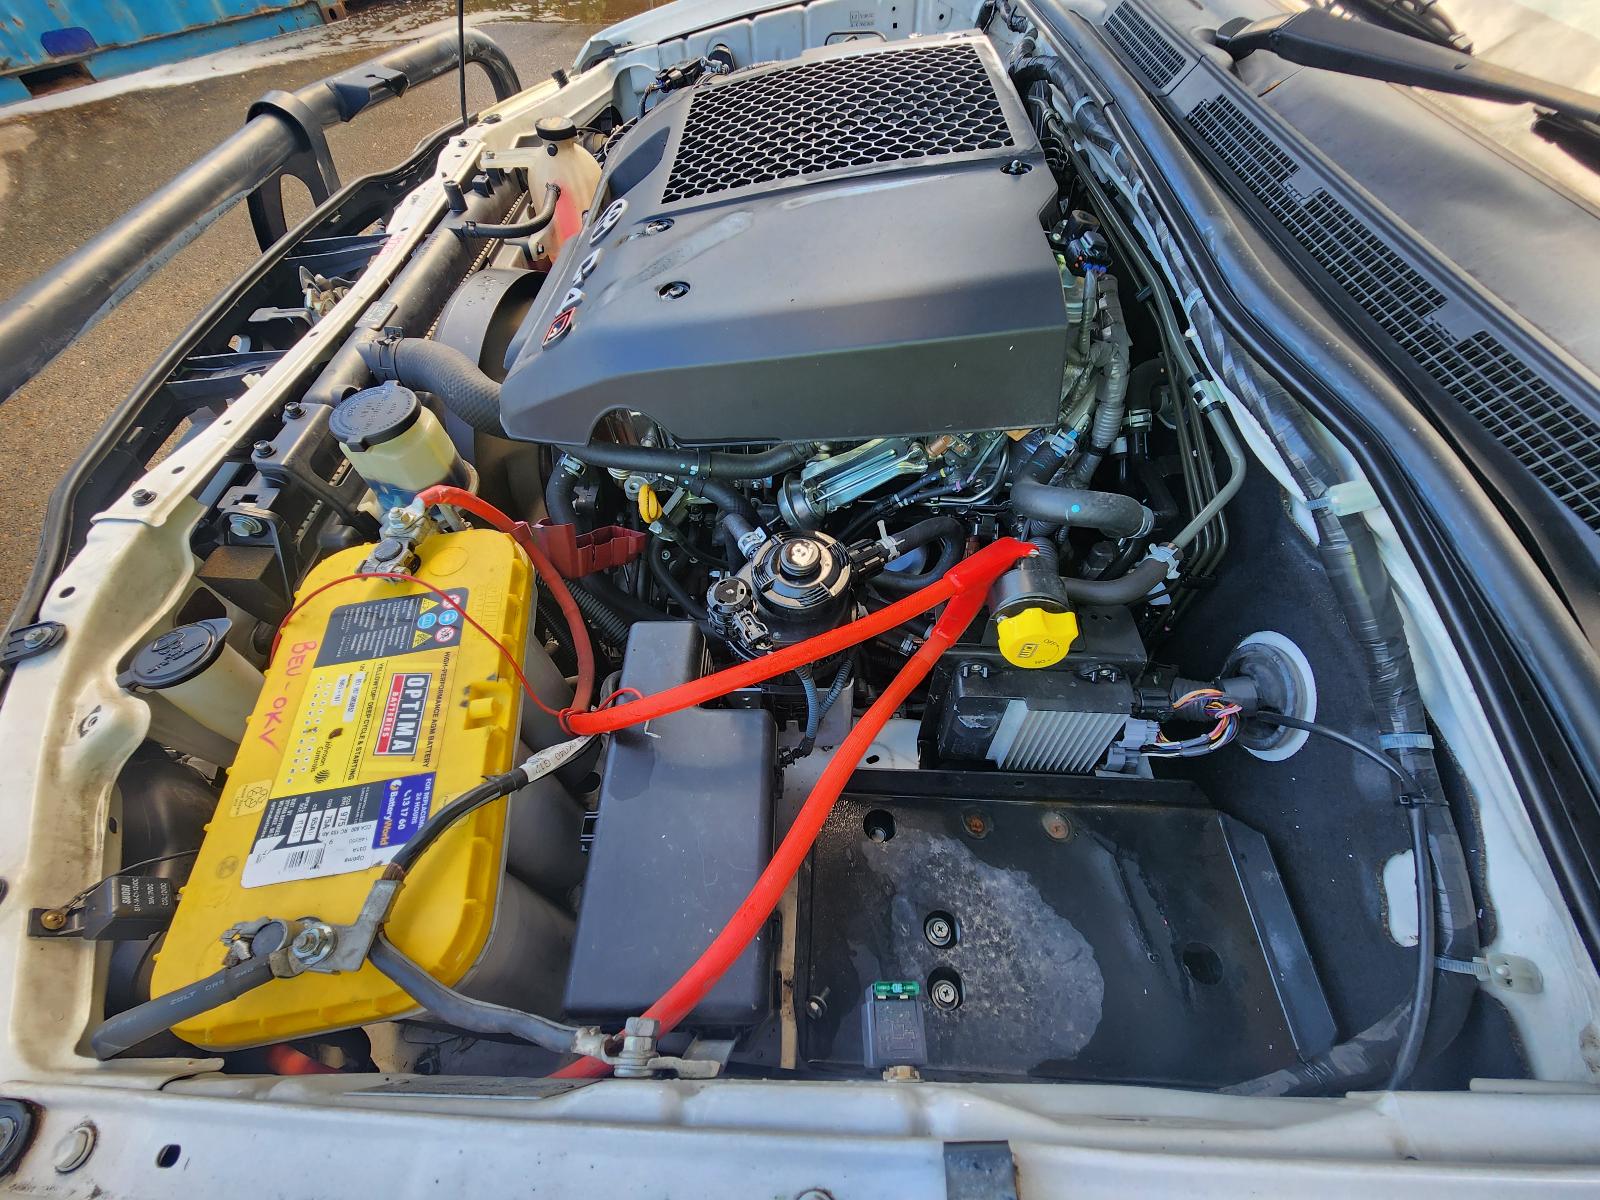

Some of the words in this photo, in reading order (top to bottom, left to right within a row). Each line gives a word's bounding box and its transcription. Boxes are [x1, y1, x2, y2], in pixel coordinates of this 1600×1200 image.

[431, 651, 450, 717] HIGH-PERFORMANCE
[363, 702, 374, 718] DEEP
[380, 691, 399, 737] BATTERIES
[390, 676, 426, 751] OPTIMA
[358, 719, 369, 739] CYCLE
[428, 719, 438, 734] AGM
[309, 746, 323, 772] Controls
[318, 741, 333, 766] Johnson
[421, 735, 435, 768] BATTERY
[347, 746, 362, 780] STARTING
[423, 778, 431, 790] FOR
[401, 796, 410, 806] 13
[414, 791, 422, 800] 24
[336, 811, 348, 827] 975
[399, 807, 409, 817] 17
[410, 801, 421, 824] HOURS
[396, 818, 406, 830] 60
